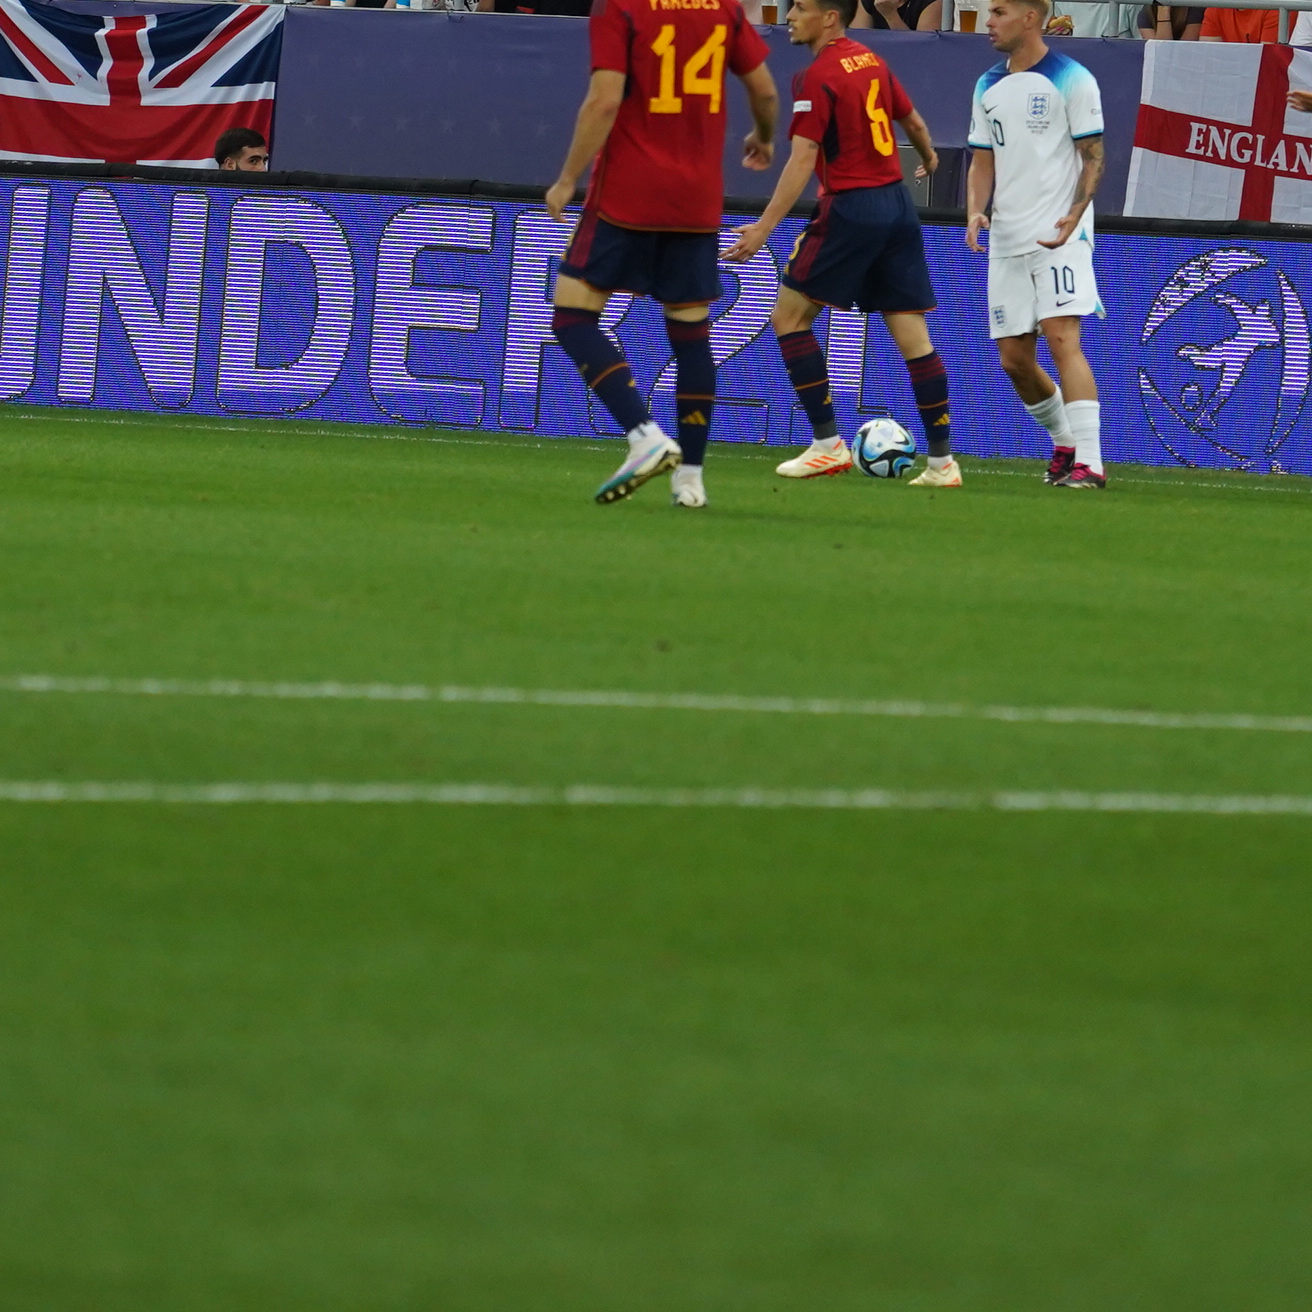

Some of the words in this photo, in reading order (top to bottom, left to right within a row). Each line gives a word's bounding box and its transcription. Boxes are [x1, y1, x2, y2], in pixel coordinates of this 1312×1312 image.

[650, 24, 727, 115] 14
[866, 78, 894, 157] 6
[1050, 265, 1075, 295] 10
